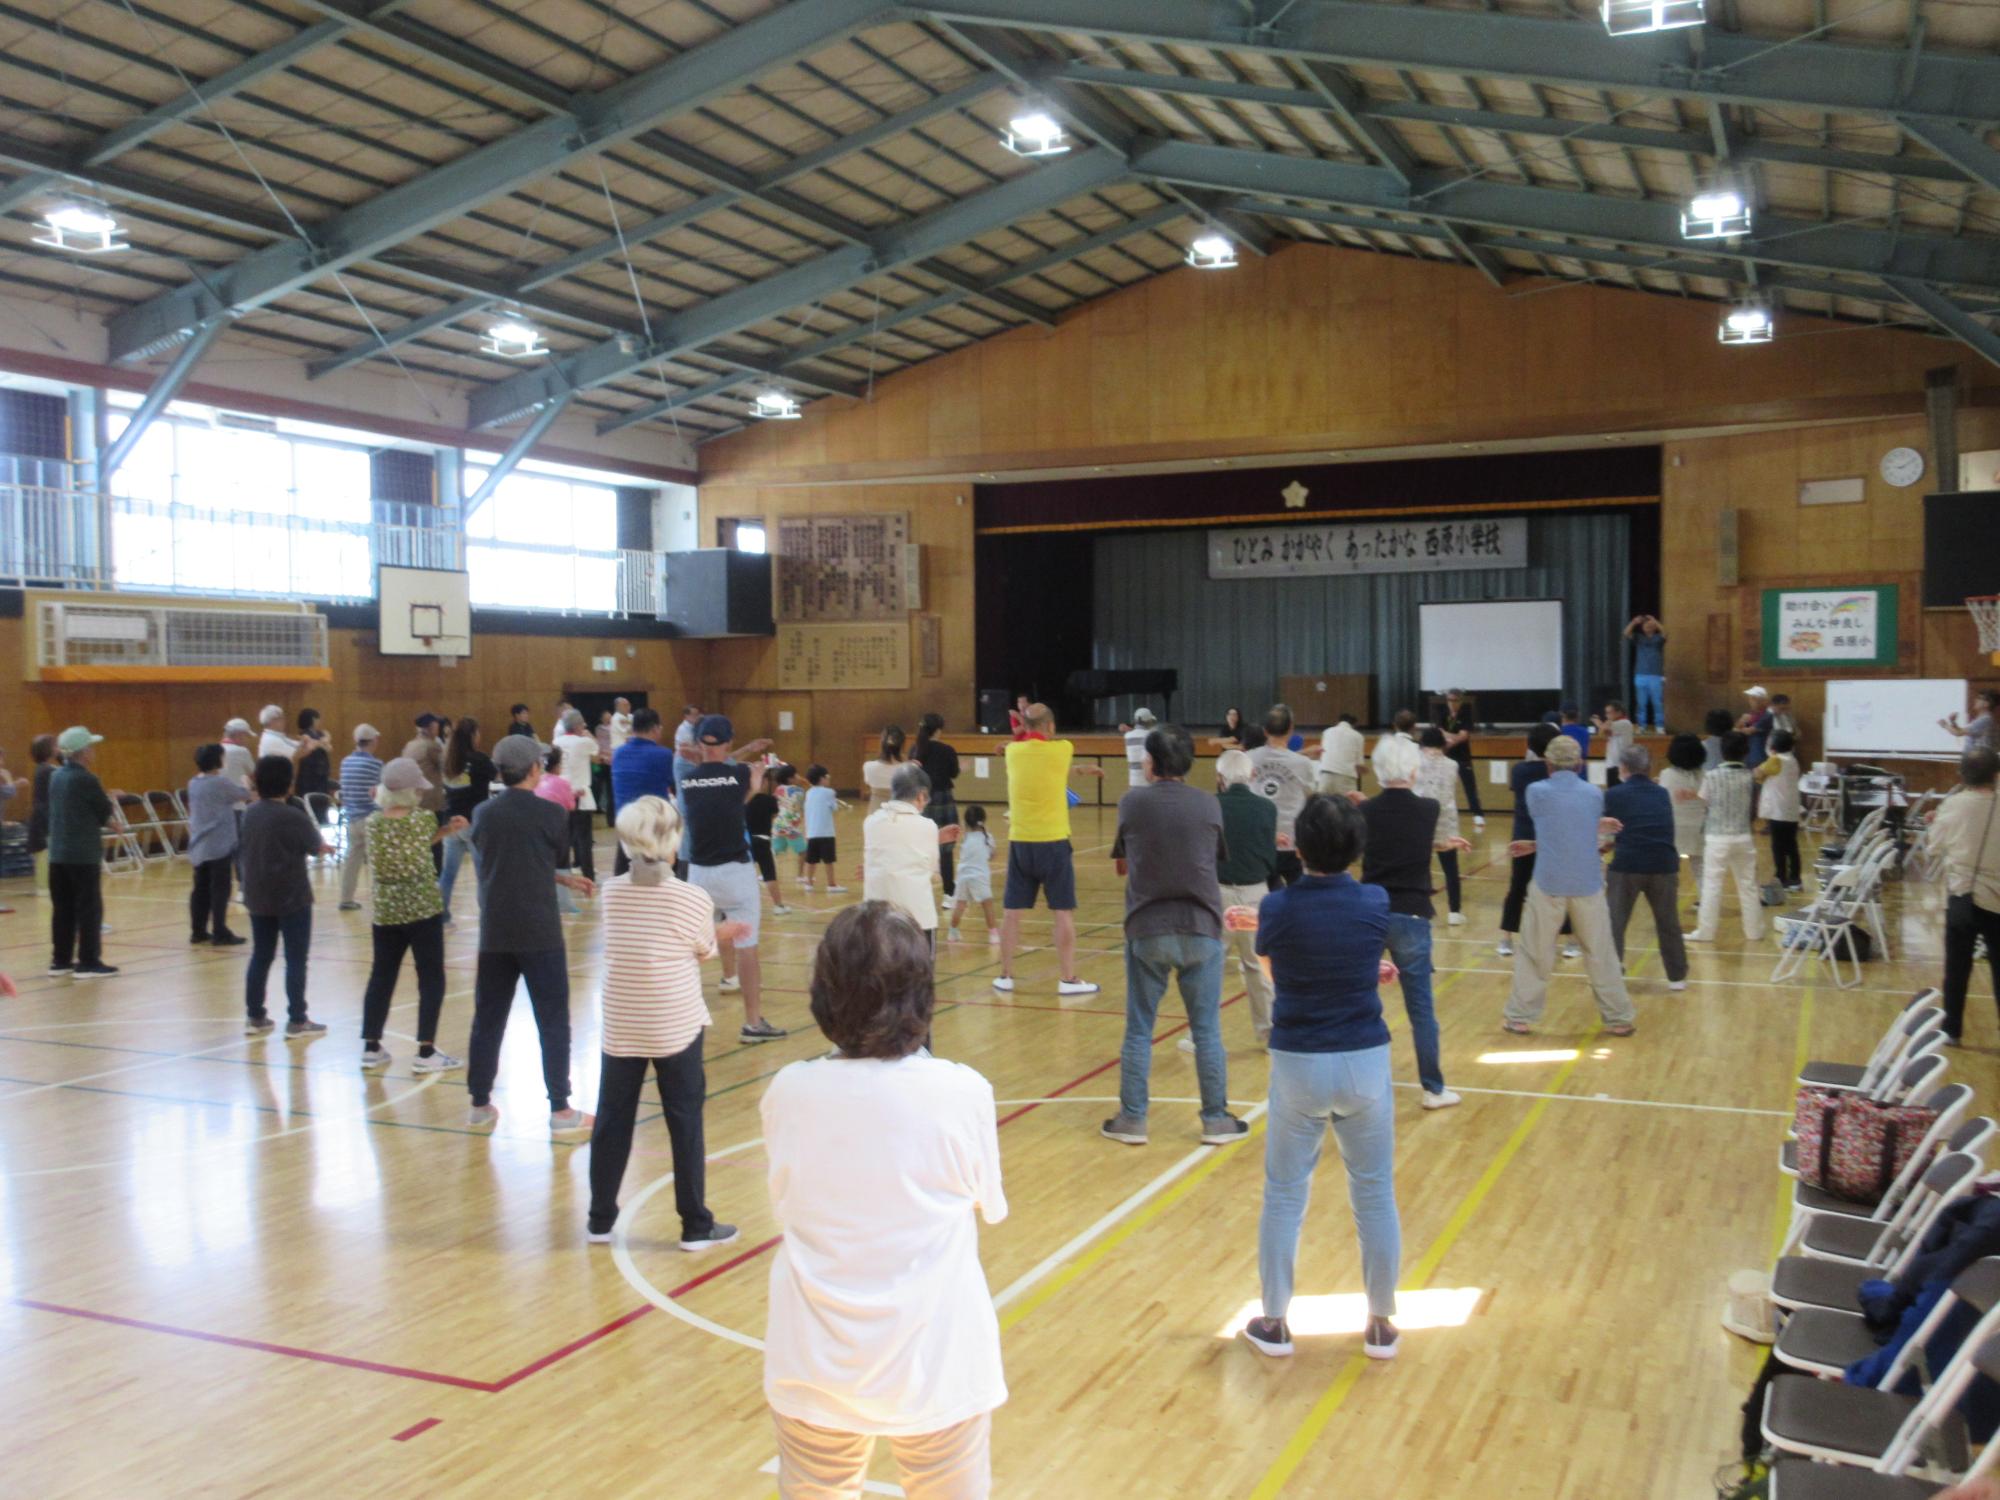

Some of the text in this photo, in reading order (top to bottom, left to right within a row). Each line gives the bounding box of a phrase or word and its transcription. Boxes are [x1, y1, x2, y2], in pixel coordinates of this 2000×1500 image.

[1233, 523, 1502, 564] ひとみ かがやく あったかな 西原小学校
[1792, 617, 1864, 629] みんな仲良し
